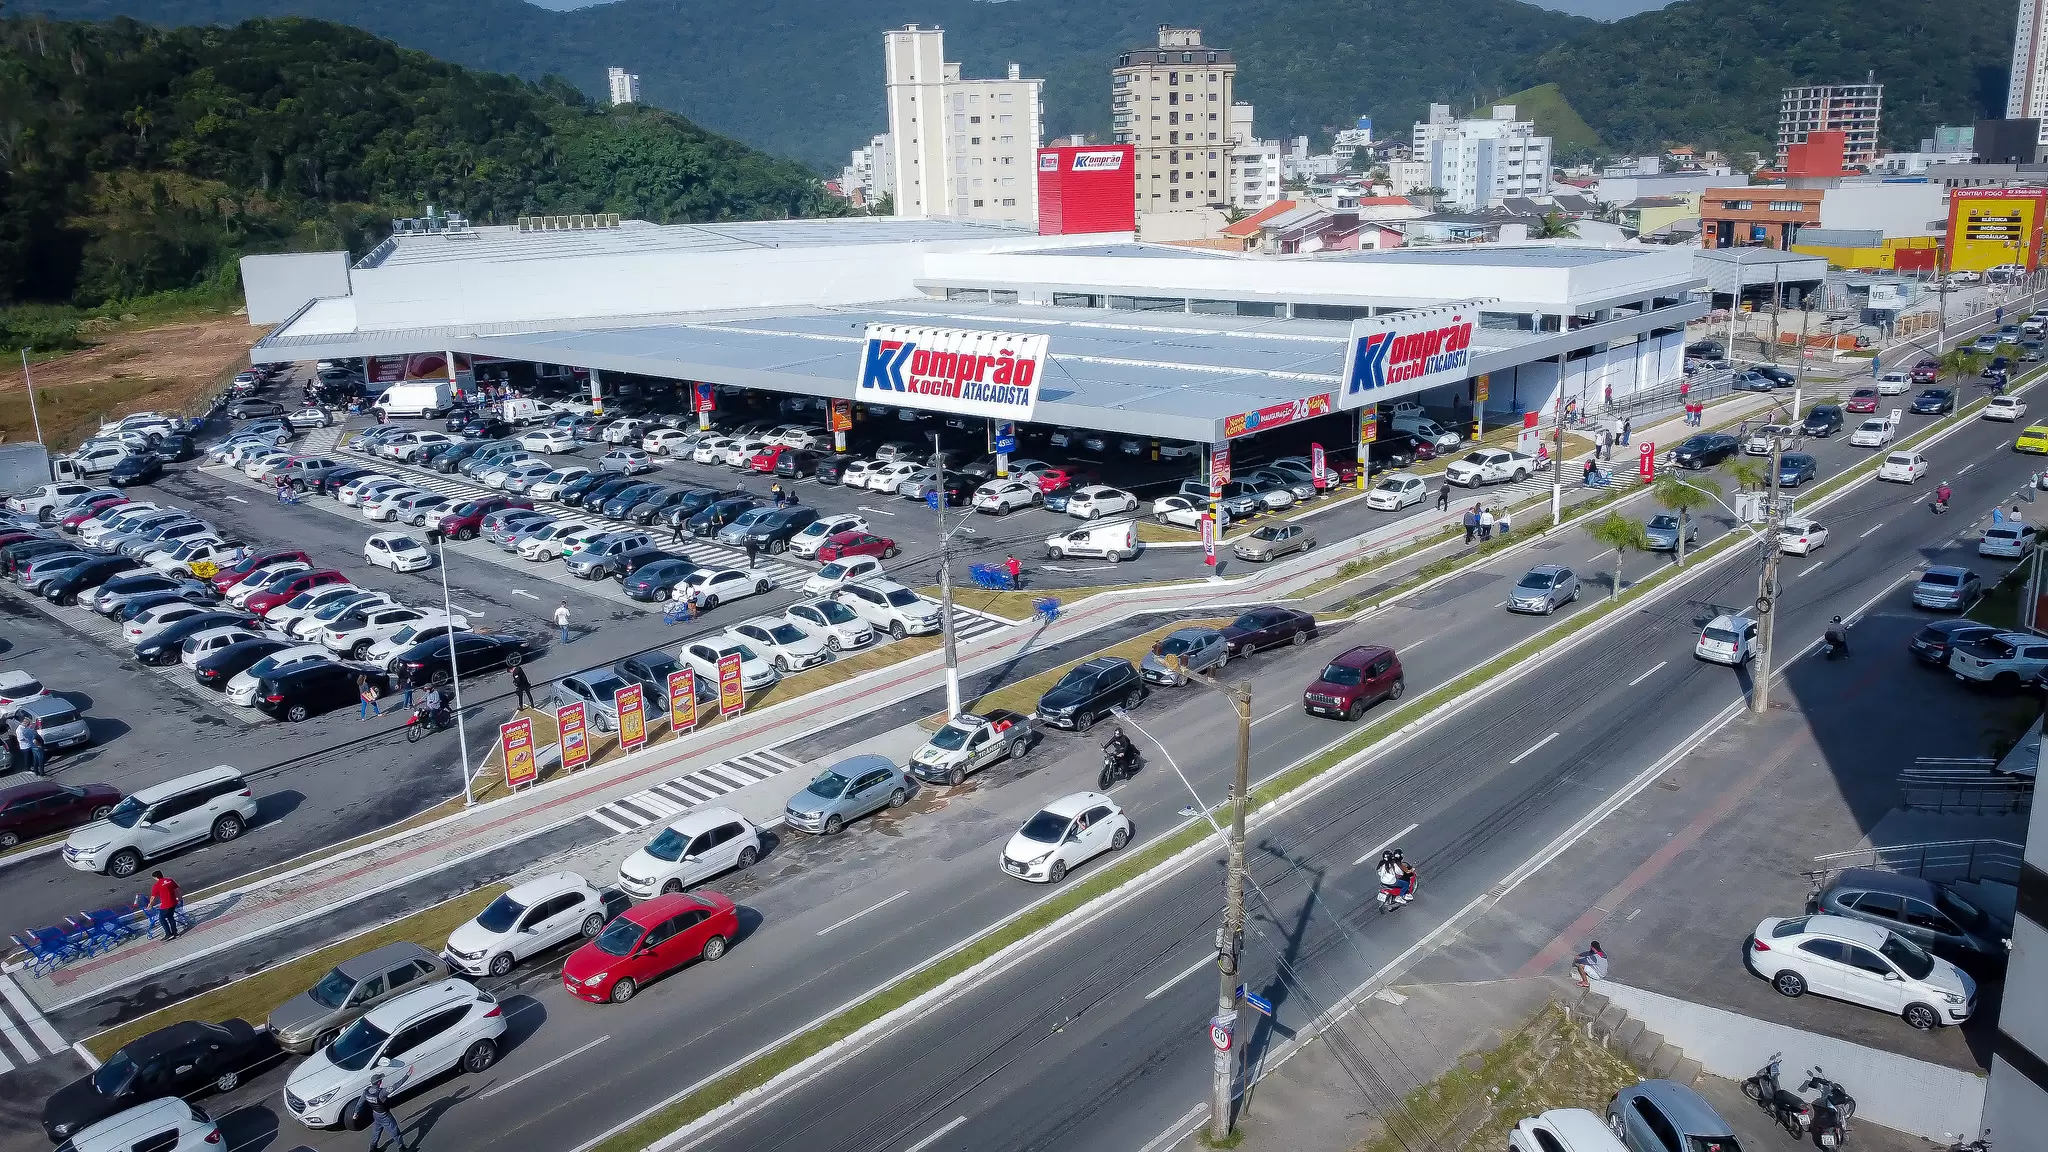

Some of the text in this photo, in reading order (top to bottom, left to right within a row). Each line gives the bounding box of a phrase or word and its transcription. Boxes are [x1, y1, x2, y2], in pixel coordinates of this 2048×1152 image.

[1424, 349, 1468, 376] ATACADISTA
[962, 382, 1030, 406] ATACADISTA
[1260, 407, 1292, 422] INAUGURAÇÃO
[1292, 398, 1309, 420] 26
[979, 740, 1007, 757] TRÂNSITO
[1215, 1029, 1225, 1042] 60
